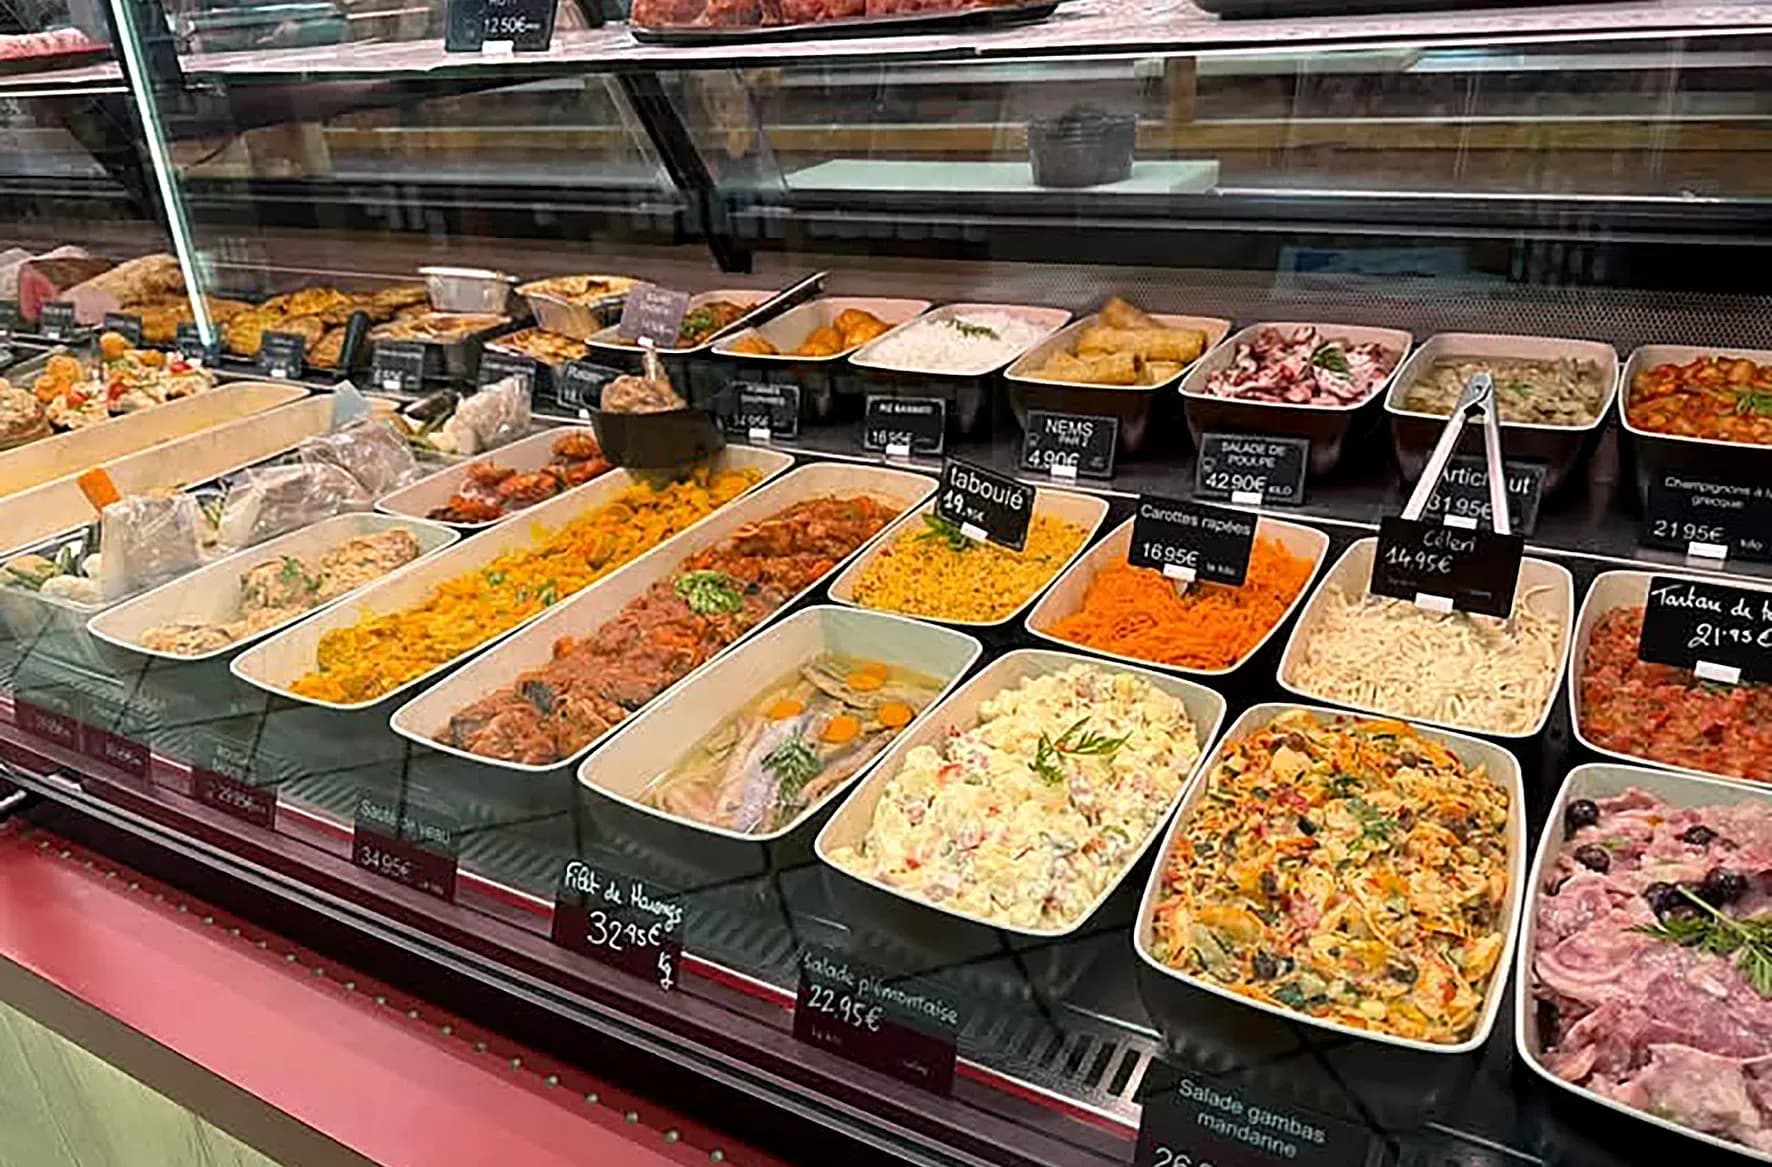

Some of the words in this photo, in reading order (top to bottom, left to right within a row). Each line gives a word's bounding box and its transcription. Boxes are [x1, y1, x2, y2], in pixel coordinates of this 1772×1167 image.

[1045, 418, 1094, 437] NEMS
[1221, 441, 1266, 455] SALADE
[1268, 444, 1286, 456] DE
[1664, 476, 1751, 495] Champignons
[1140, 504, 1198, 527] Carottes
[1423, 529, 1477, 552] Céleri
[1730, 597, 1754, 620] de
[564, 861, 601, 895] Filet
[604, 881, 622, 905] de
[803, 951, 855, 987] Salade
[857, 975, 958, 1025] piémontaise
[807, 984, 884, 1032] 22.95€
[1178, 1078, 1244, 1115] Salade
[1247, 1105, 1327, 1144] gambas
